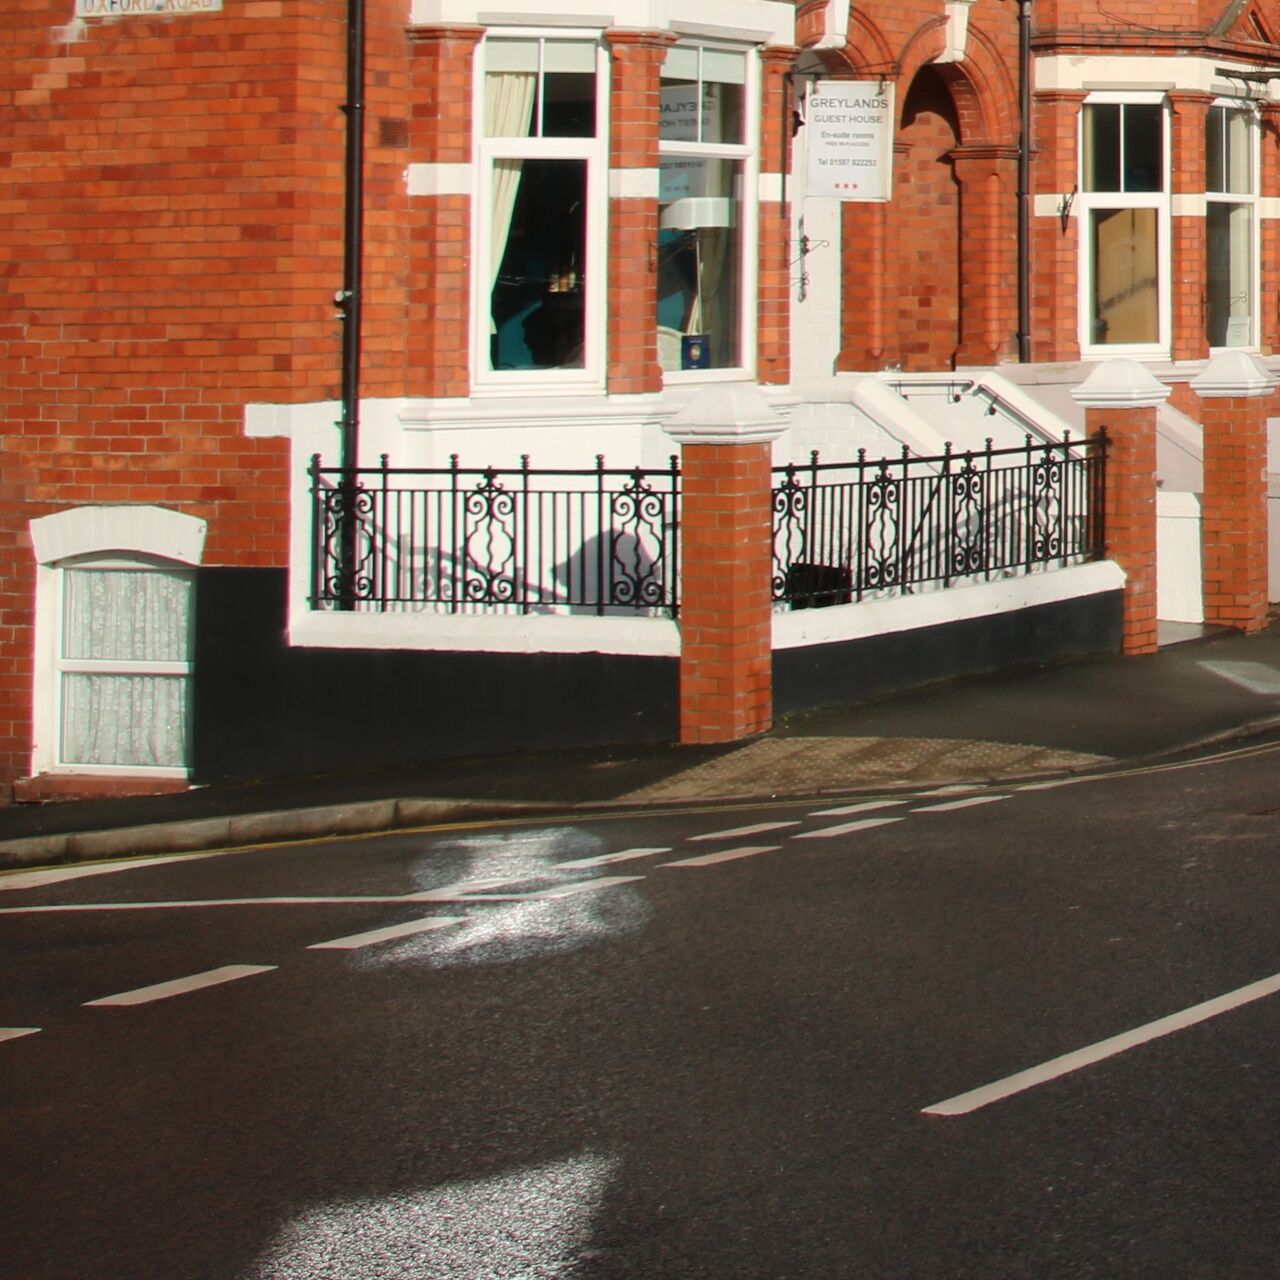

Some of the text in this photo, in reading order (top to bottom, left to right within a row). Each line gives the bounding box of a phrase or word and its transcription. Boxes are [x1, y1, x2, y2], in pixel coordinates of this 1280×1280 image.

[810, 98, 889, 109] GREYLANDS
[814, 114, 884, 125] GUEST HOUSE
